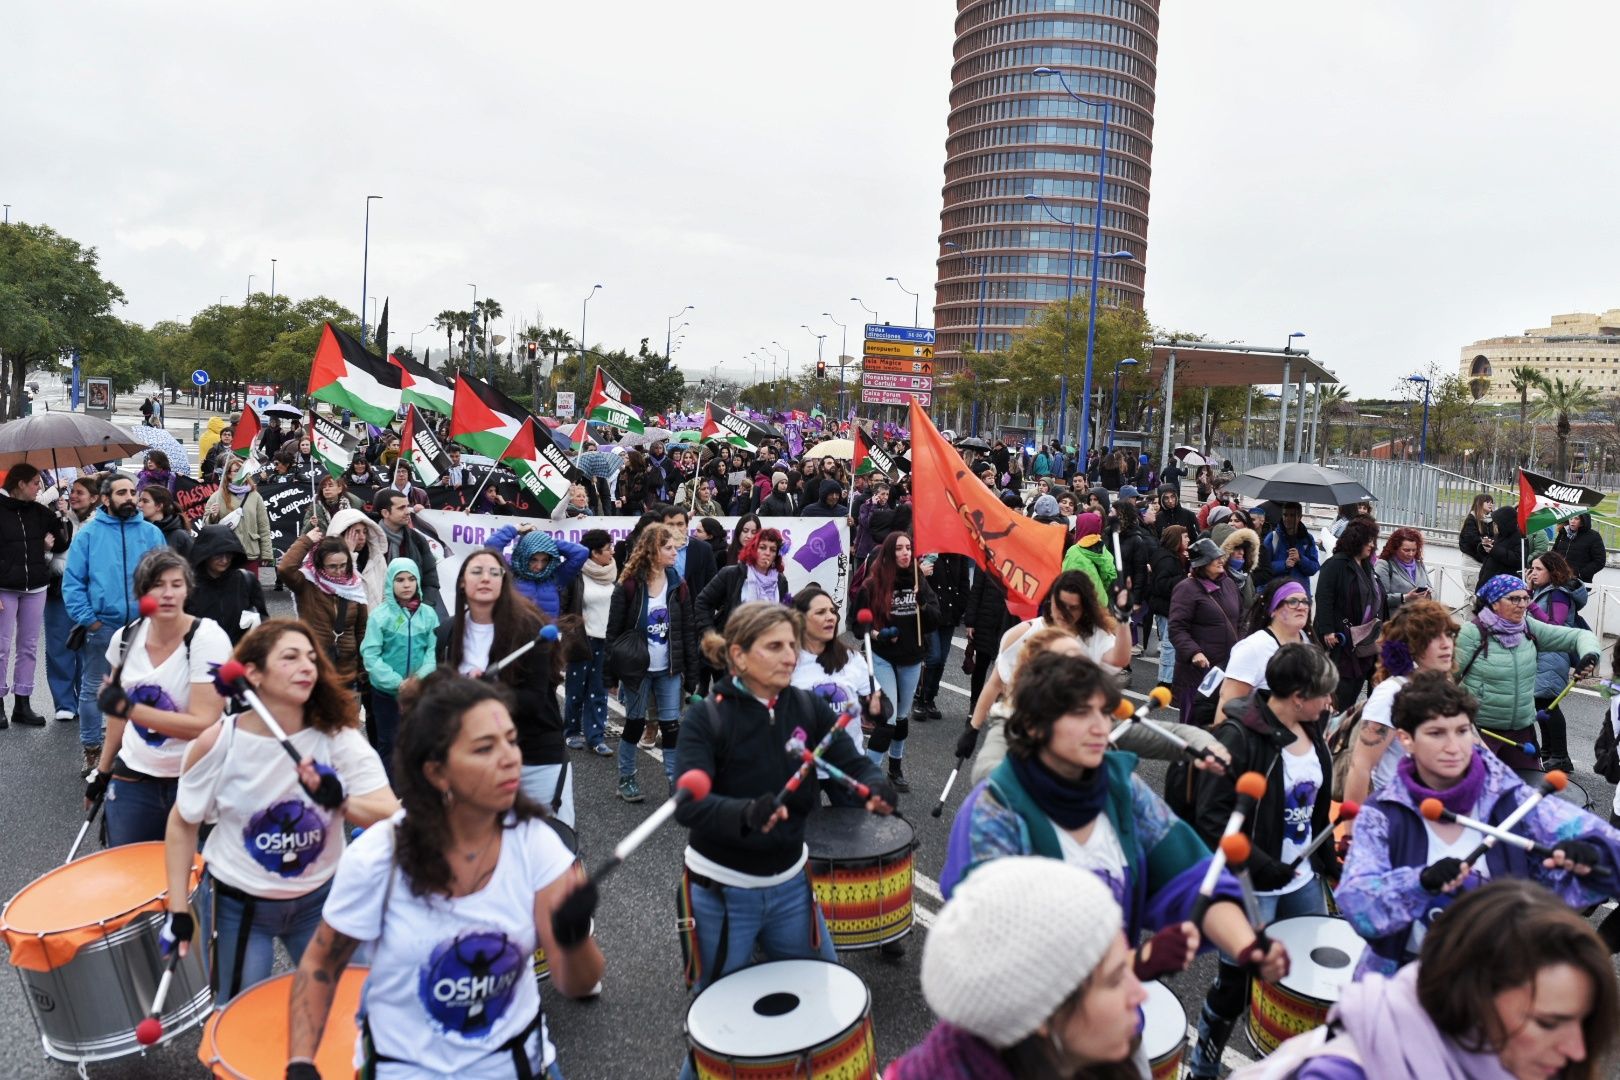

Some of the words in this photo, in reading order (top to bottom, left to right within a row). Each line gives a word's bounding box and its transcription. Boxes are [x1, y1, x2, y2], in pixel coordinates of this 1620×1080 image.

[866, 345, 901, 353] aeropuerto
[607, 410, 629, 428] LIBRE
[721, 414, 751, 438] SAHARA
[315, 418, 345, 445] SAHARA
[414, 429, 440, 461] SAHARA
[542, 443, 571, 475] SAHARA
[868, 444, 893, 473] SAHARA
[520, 470, 545, 497] LIBRE
[1544, 484, 1584, 504] SAHARA
[452, 524, 486, 545] POR
[255, 828, 321, 851] OSHUN
